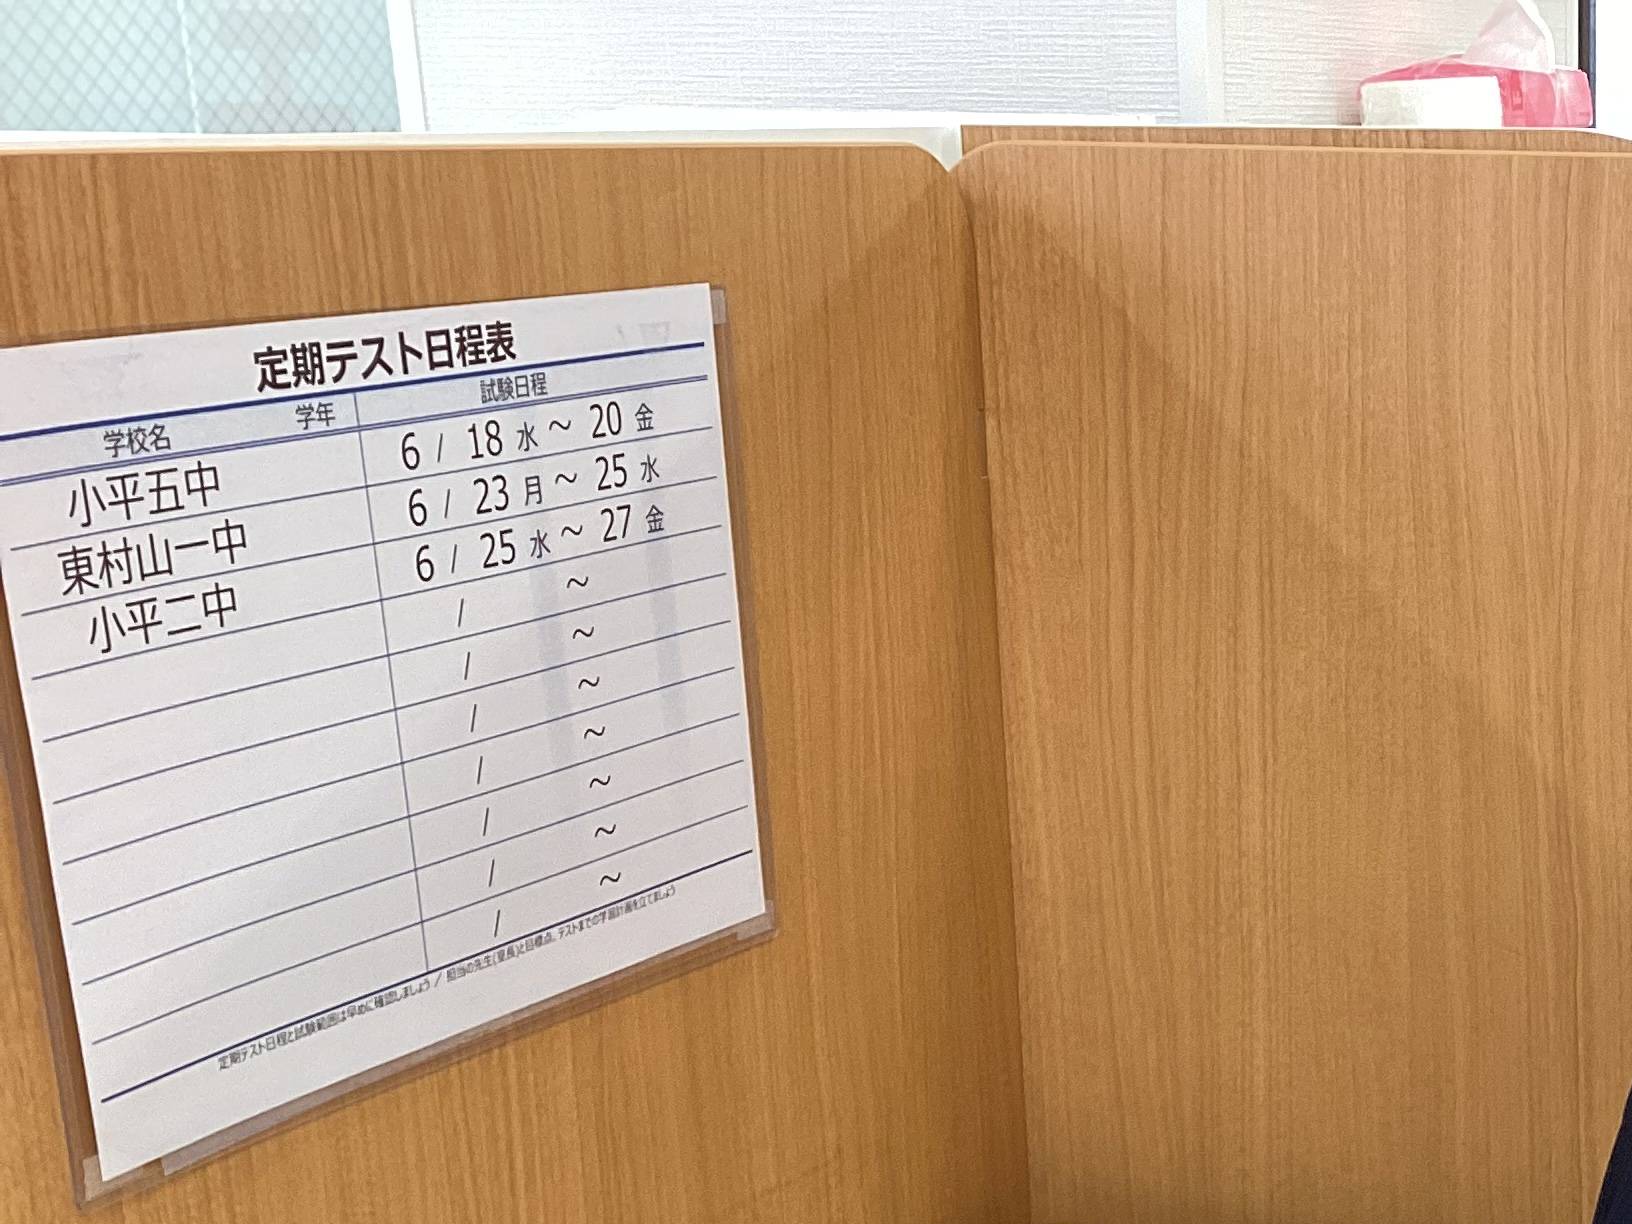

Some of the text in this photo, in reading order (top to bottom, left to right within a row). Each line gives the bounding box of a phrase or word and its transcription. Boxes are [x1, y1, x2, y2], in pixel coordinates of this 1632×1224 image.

[253, 320, 517, 393] 定期テスト日程表
[480, 371, 548, 404] 試験日程
[103, 422, 172, 458] 学校名
[295, 401, 336, 430] 学年
[401, 432, 421, 471] 6
[467, 419, 504, 460] 18
[516, 421, 539, 452] 水
[590, 401, 623, 439] 20
[635, 402, 655, 433] 金
[68, 460, 221, 528] 小平五中
[408, 488, 428, 527] 6
[473, 474, 510, 515] 23
[524, 475, 543, 507] 月
[595, 452, 628, 491] 25
[640, 454, 660, 484] 水
[57, 518, 248, 597] 東村山一中
[415, 544, 435, 582] 6
[480, 528, 516, 569] 25
[529, 529, 551, 559] 水
[601, 504, 632, 543] 27
[645, 504, 665, 534] 金
[89, 582, 238, 654] 小平二中
